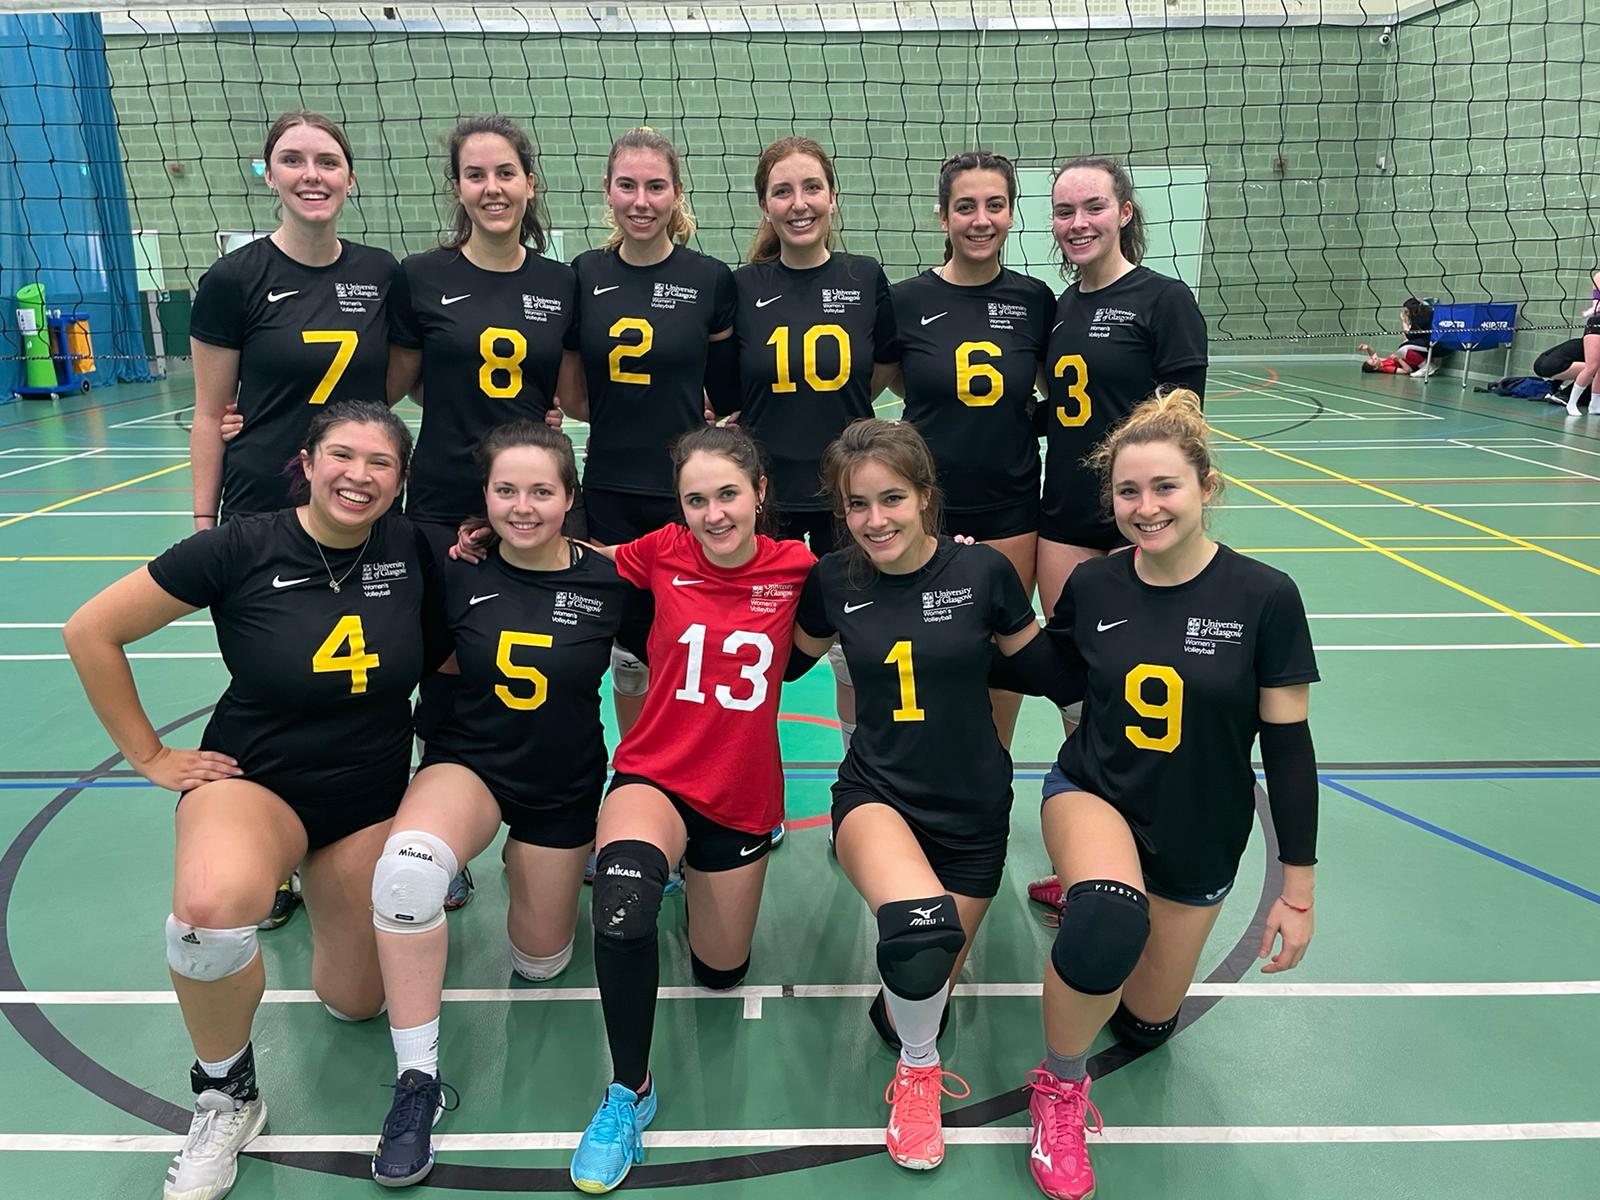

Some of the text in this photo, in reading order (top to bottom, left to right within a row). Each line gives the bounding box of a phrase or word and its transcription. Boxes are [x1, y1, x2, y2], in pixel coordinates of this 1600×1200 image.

[302, 330, 358, 405] 7
[478, 327, 526, 398] 8
[608, 317, 653, 386] 2
[766, 324, 851, 393] 10
[955, 341, 1005, 408] 6
[1053, 353, 1092, 428] 3
[372, 560, 406, 571] University
[380, 568, 407, 577] Glasgow
[568, 592, 604, 607] University
[574, 600, 602, 613] Glasgow
[770, 590, 793, 598] Glasgow
[934, 587, 972, 600] University
[941, 593, 973, 604] Glasgow
[1184, 638, 1216, 648] Women's
[1200, 628, 1243, 639] of Glasgow
[1202, 618, 1244, 632] University
[312, 614, 380, 695] 4
[674, 622, 775, 713] 13
[1183, 645, 1216, 655] Volleyball
[493, 630, 553, 712] 5
[883, 641, 926, 722] 1
[1124, 662, 1185, 754] 9
